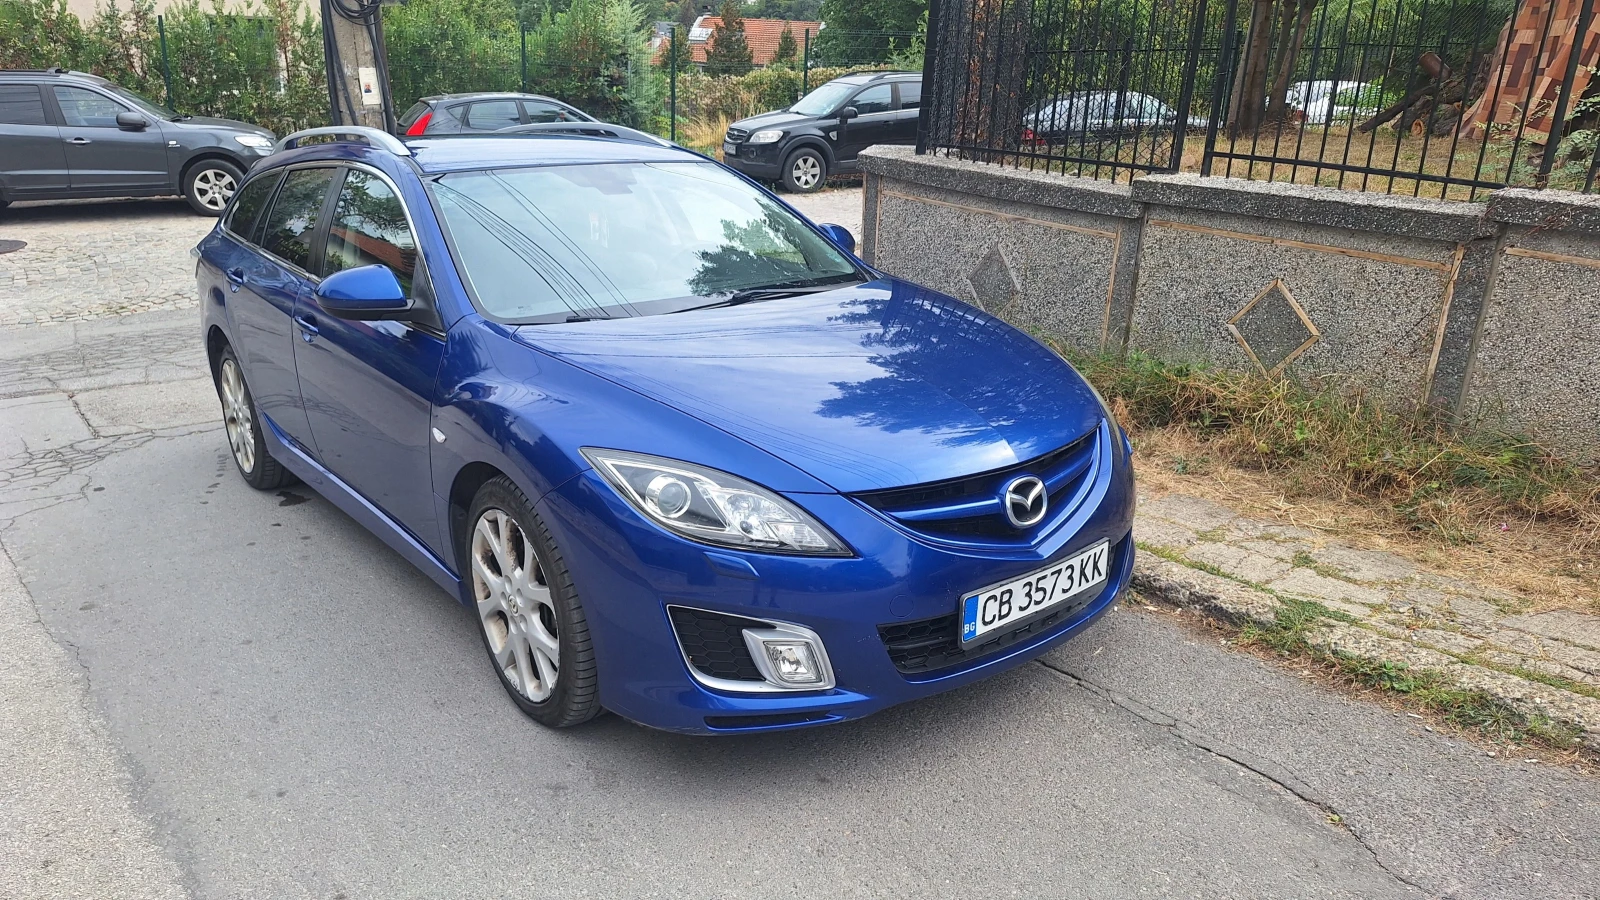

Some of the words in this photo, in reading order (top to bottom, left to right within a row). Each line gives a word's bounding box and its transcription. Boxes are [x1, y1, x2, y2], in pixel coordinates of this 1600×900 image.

[981, 588, 1013, 626] CB
[1018, 563, 1075, 612] 3573
[1078, 548, 1105, 587] KK
[963, 621, 976, 634] BG
